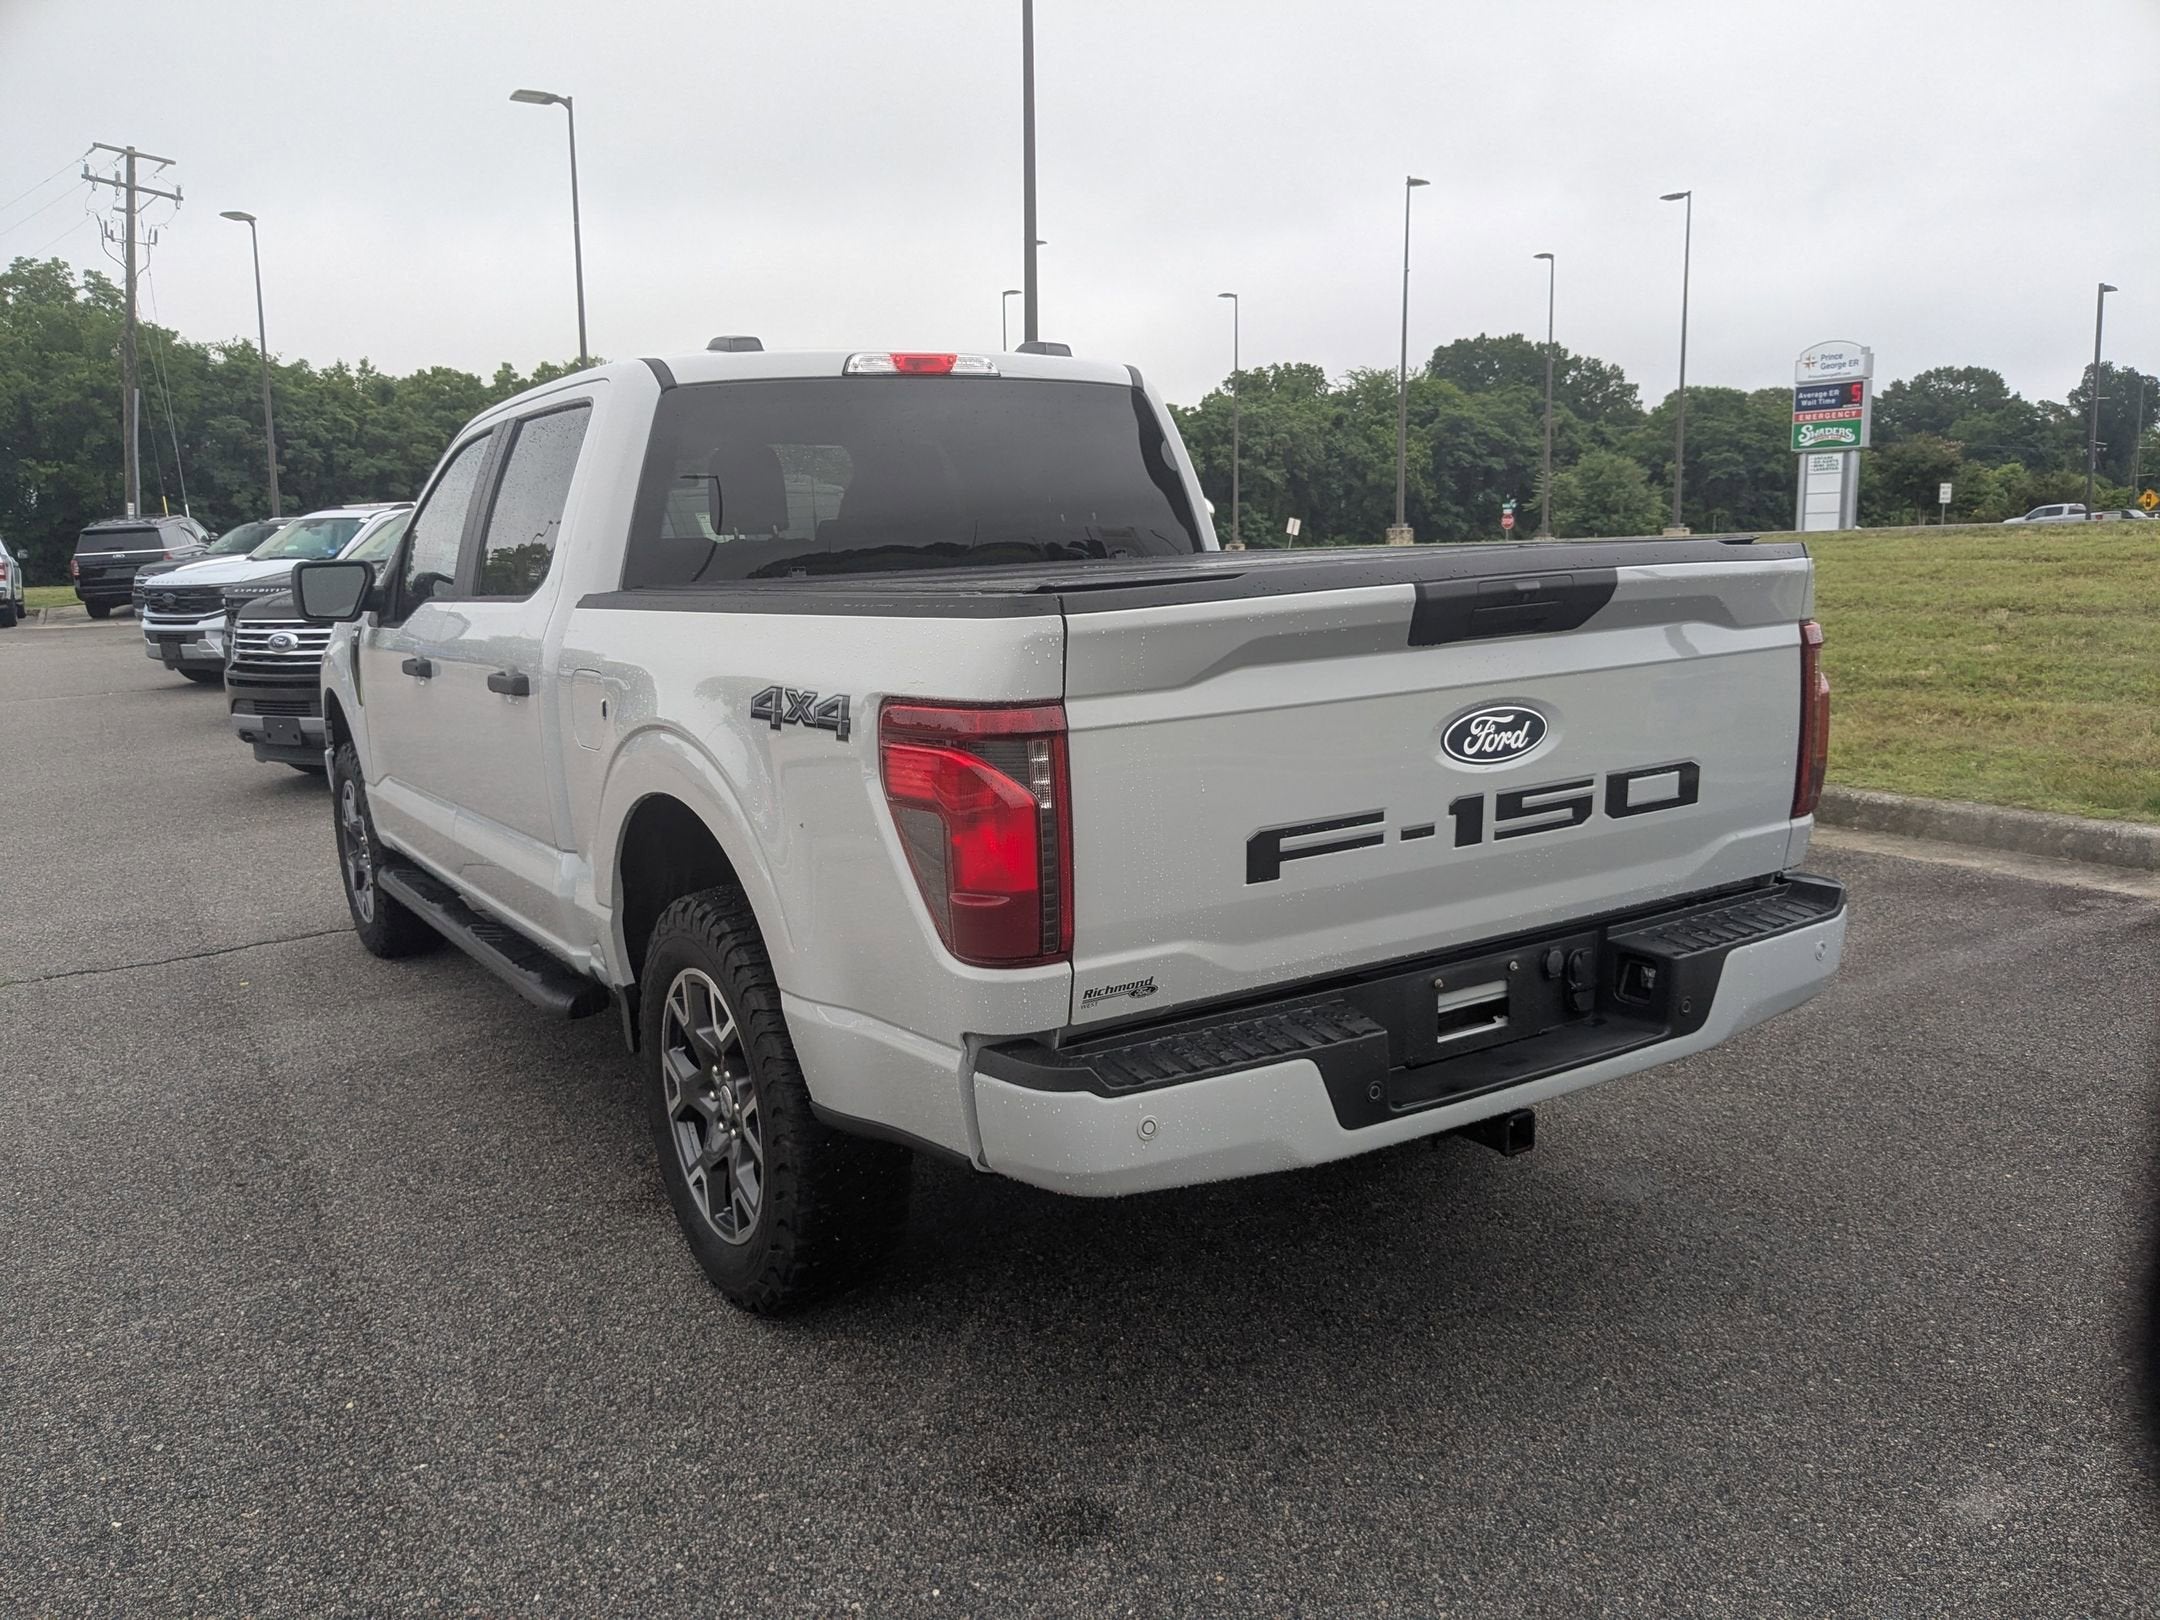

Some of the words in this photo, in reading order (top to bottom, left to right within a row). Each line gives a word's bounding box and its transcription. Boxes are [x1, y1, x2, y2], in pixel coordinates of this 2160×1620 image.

[1820, 360, 1847, 370] George
[1848, 359, 1859, 367] ER
[1798, 391, 1828, 399] Average
[1828, 389, 1840, 397] ER
[1850, 383, 1861, 403] 5
[1798, 411, 1857, 420] EMERGENCY
[1463, 714, 1531, 755] Ford
[1246, 759, 1700, 885] F-150
[1082, 976, 1154, 999] Richmond
